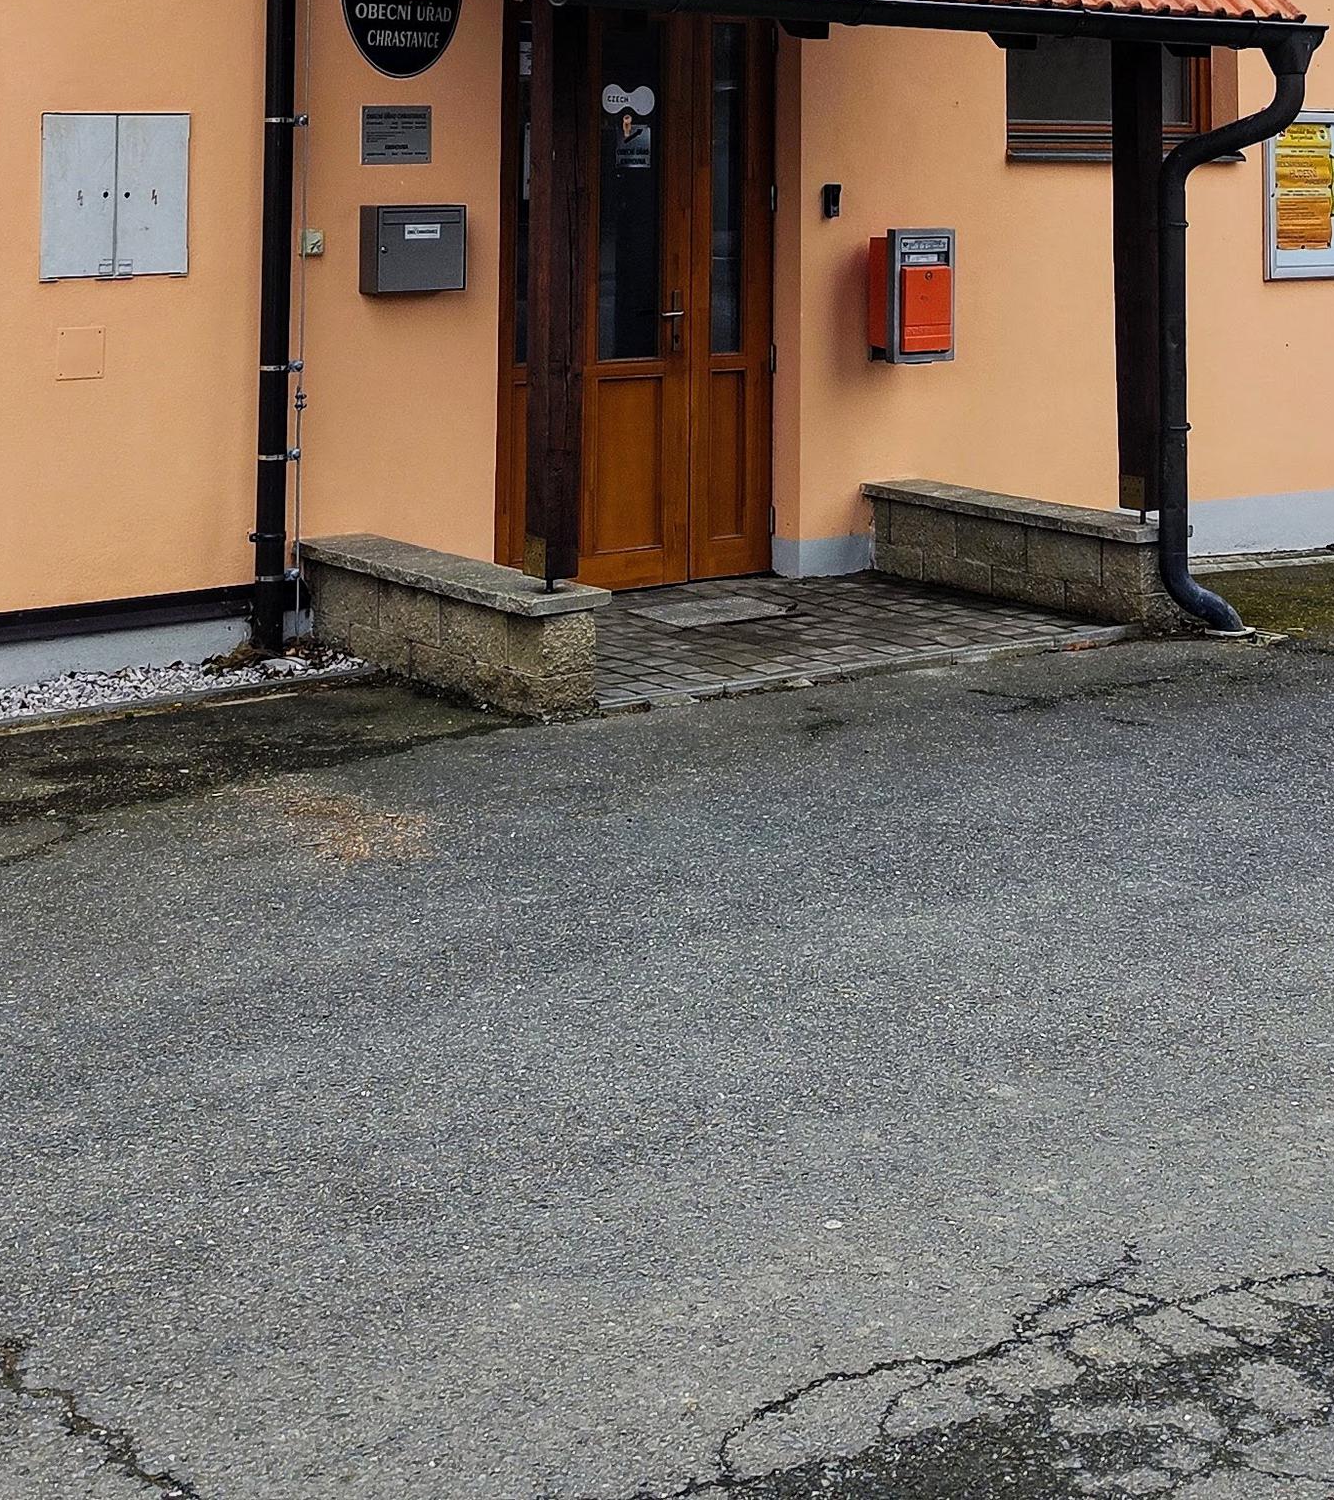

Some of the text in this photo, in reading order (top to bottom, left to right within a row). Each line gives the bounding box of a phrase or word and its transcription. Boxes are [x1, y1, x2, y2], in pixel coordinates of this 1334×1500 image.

[355, 1, 452, 22] OBECNÍ ÚŘAD
[367, 30, 440, 49] CHRASTAVICE
[607, 95, 629, 103] CZECH
